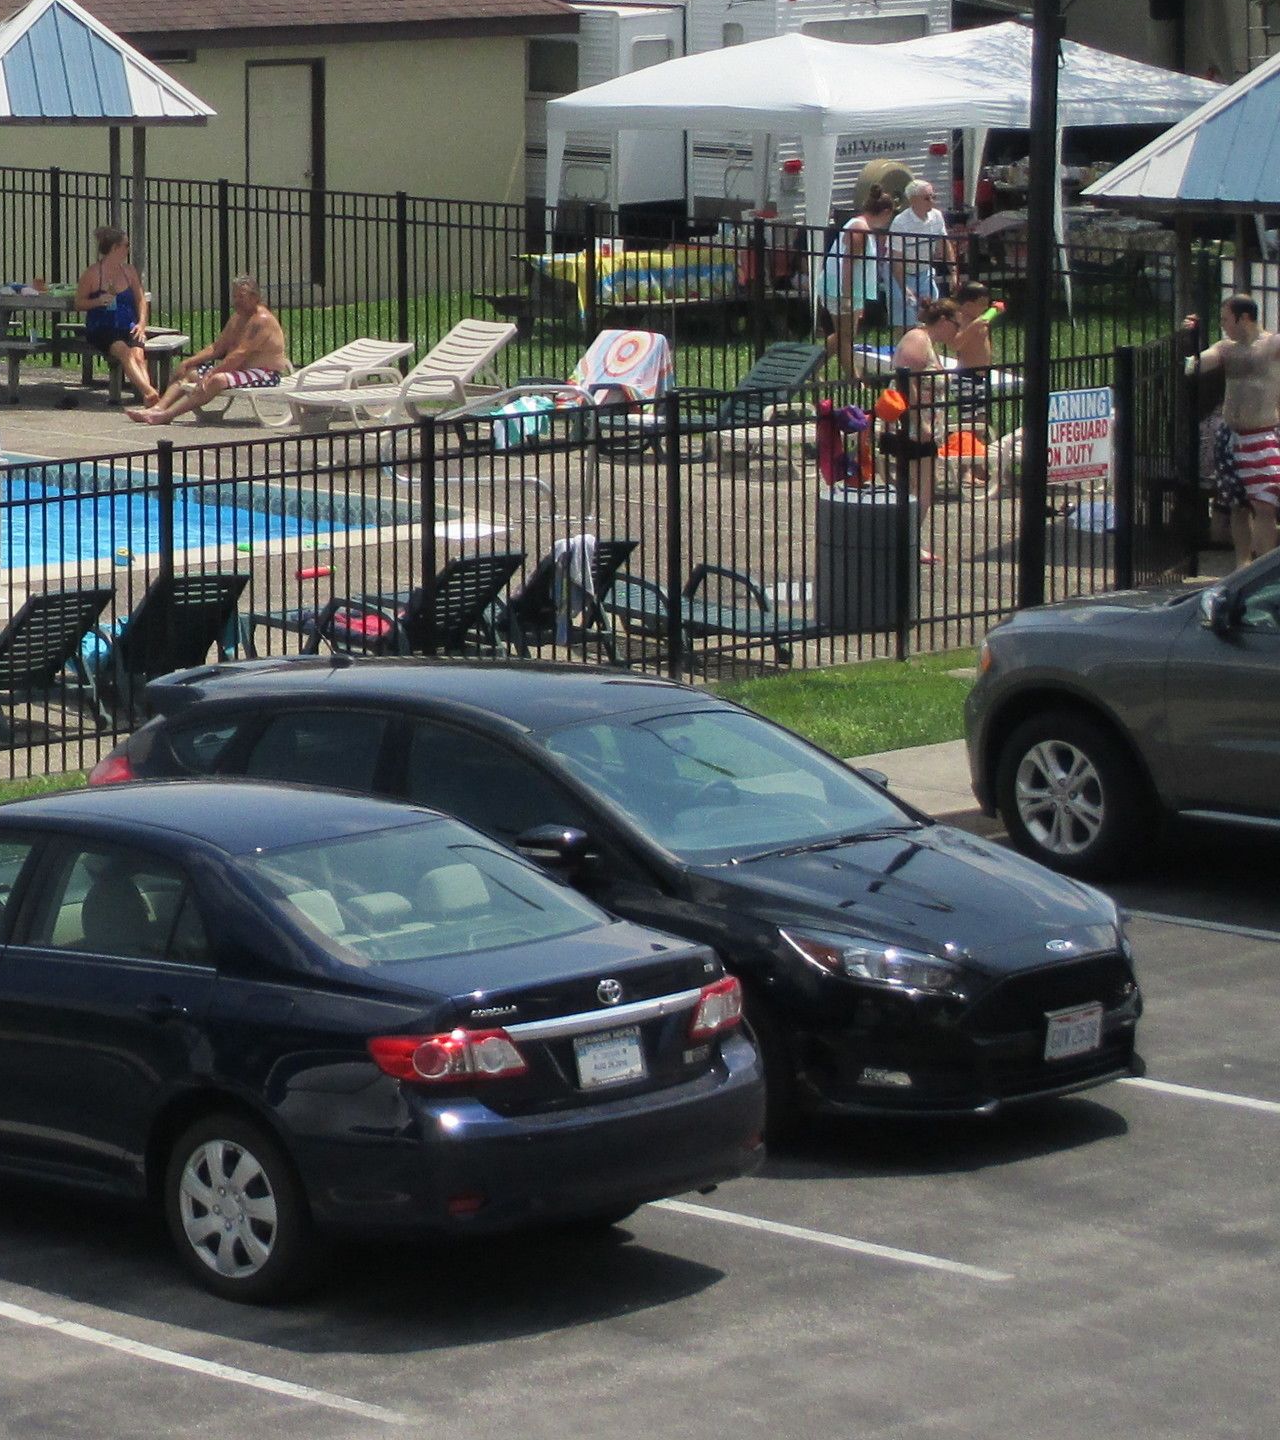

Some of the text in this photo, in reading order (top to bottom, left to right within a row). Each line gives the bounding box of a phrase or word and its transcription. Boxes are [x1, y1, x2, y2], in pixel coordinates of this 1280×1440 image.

[1048, 391, 1107, 421] ARNING
[1051, 419, 1109, 444] LIFEGUARD
[1065, 442, 1094, 465] DUTY
